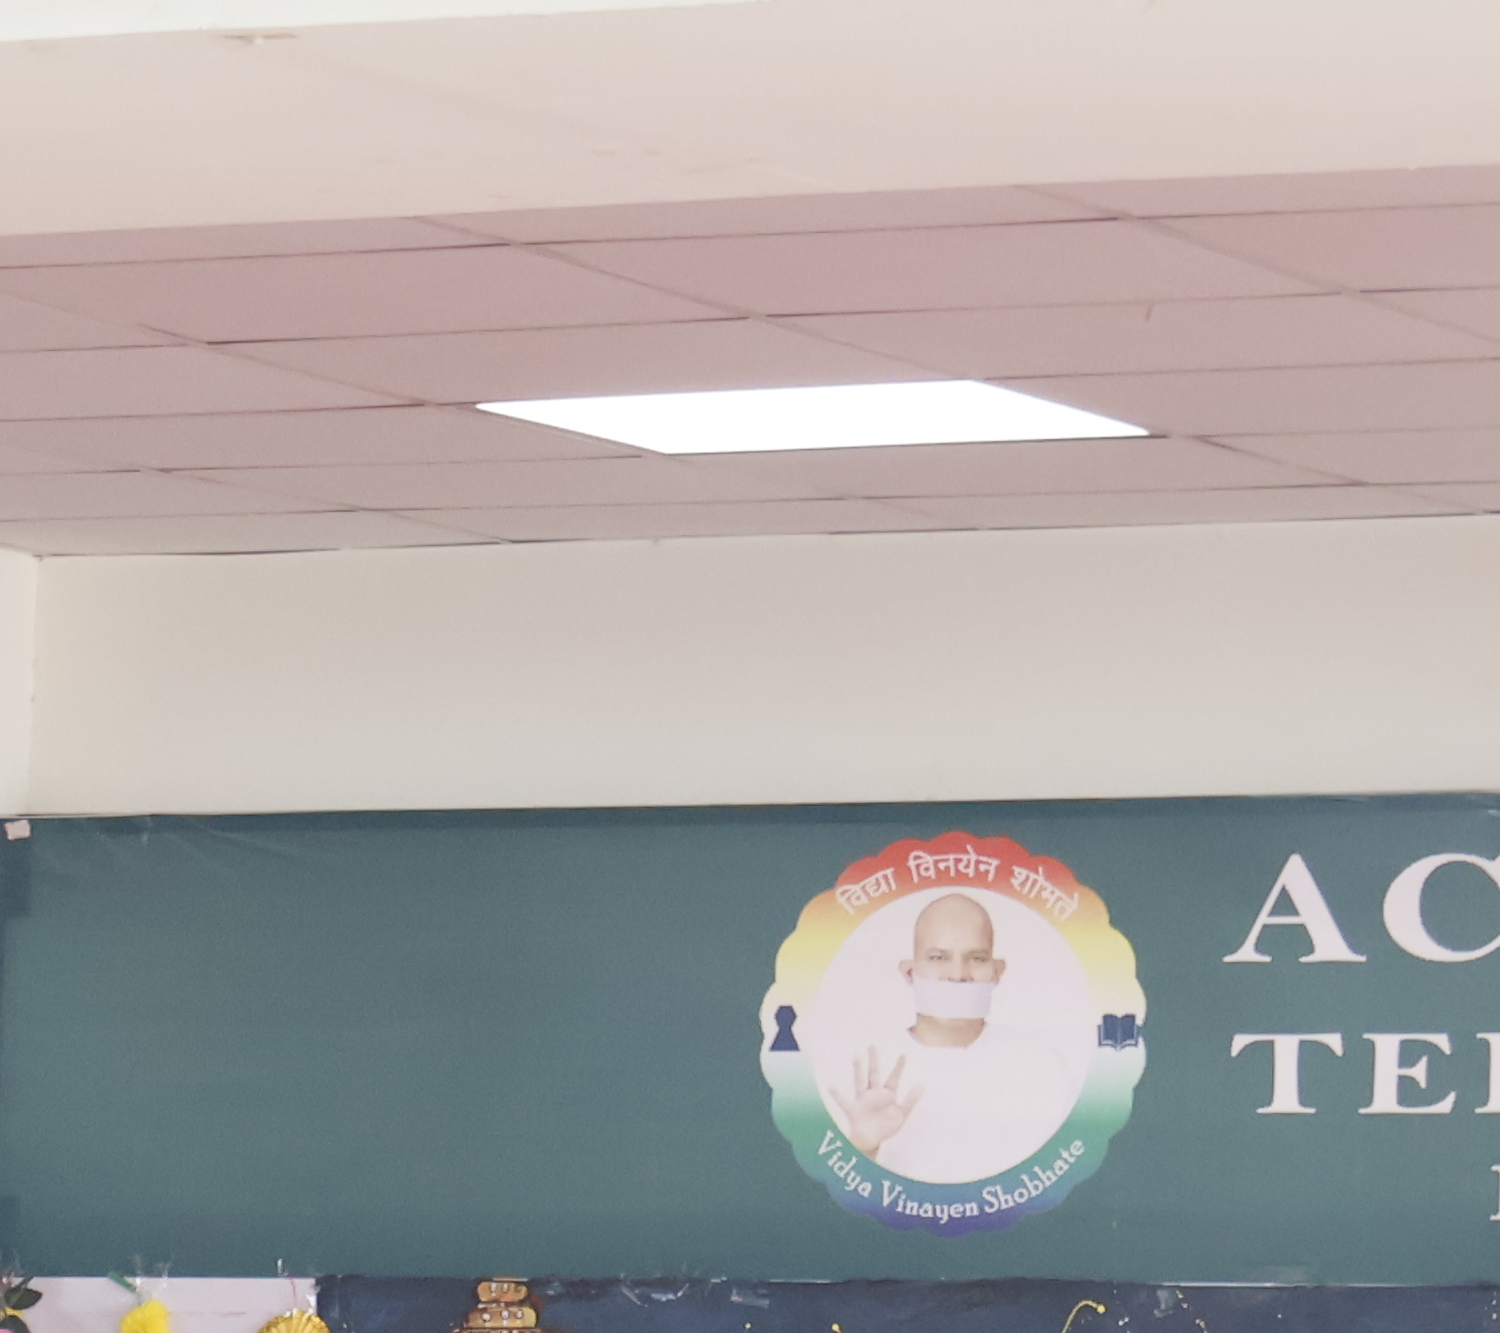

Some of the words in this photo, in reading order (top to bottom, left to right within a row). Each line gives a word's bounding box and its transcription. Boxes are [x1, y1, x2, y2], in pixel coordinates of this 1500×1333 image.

[835, 867, 898, 915] विद्या
[906, 844, 1001, 884] विनयेन
[1221, 852, 1500, 963] AC
[817, 1129, 873, 1198] Vidya
[880, 1179, 980, 1224] Vinayen
[982, 1139, 1086, 1214] Shobhate
